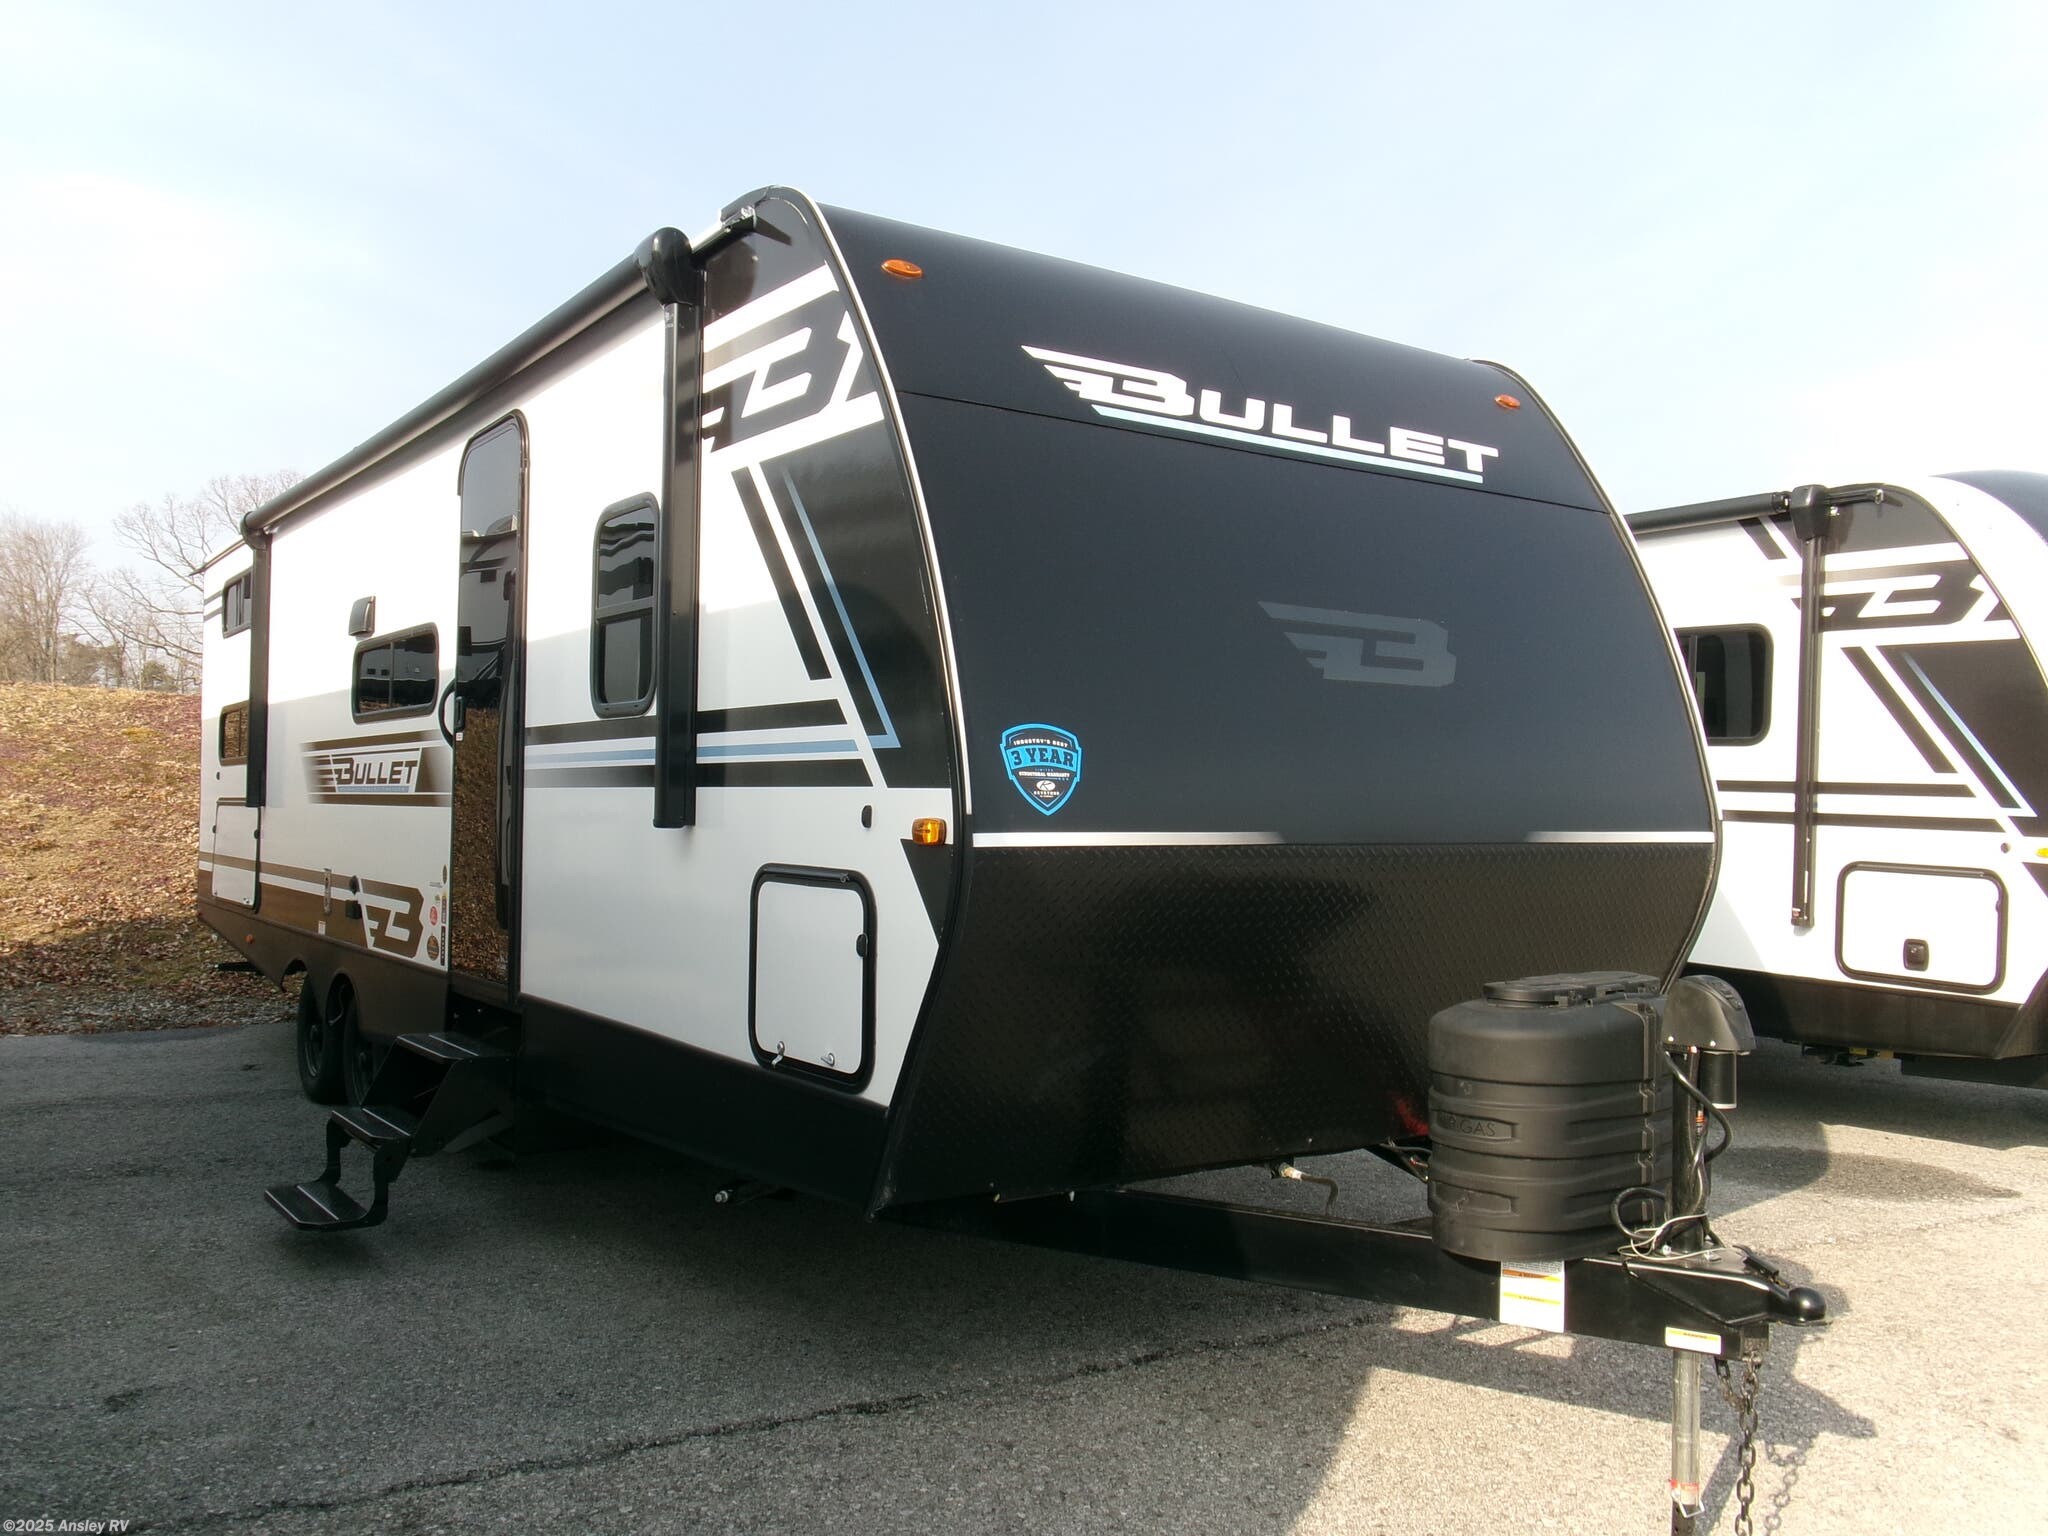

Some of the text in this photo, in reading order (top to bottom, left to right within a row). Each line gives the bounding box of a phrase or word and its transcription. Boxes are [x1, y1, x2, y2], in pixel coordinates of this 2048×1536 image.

[1021, 345, 1499, 473] BULLET
[331, 757, 418, 785] BULLET
[1010, 747, 1074, 768] 3 YEAR
